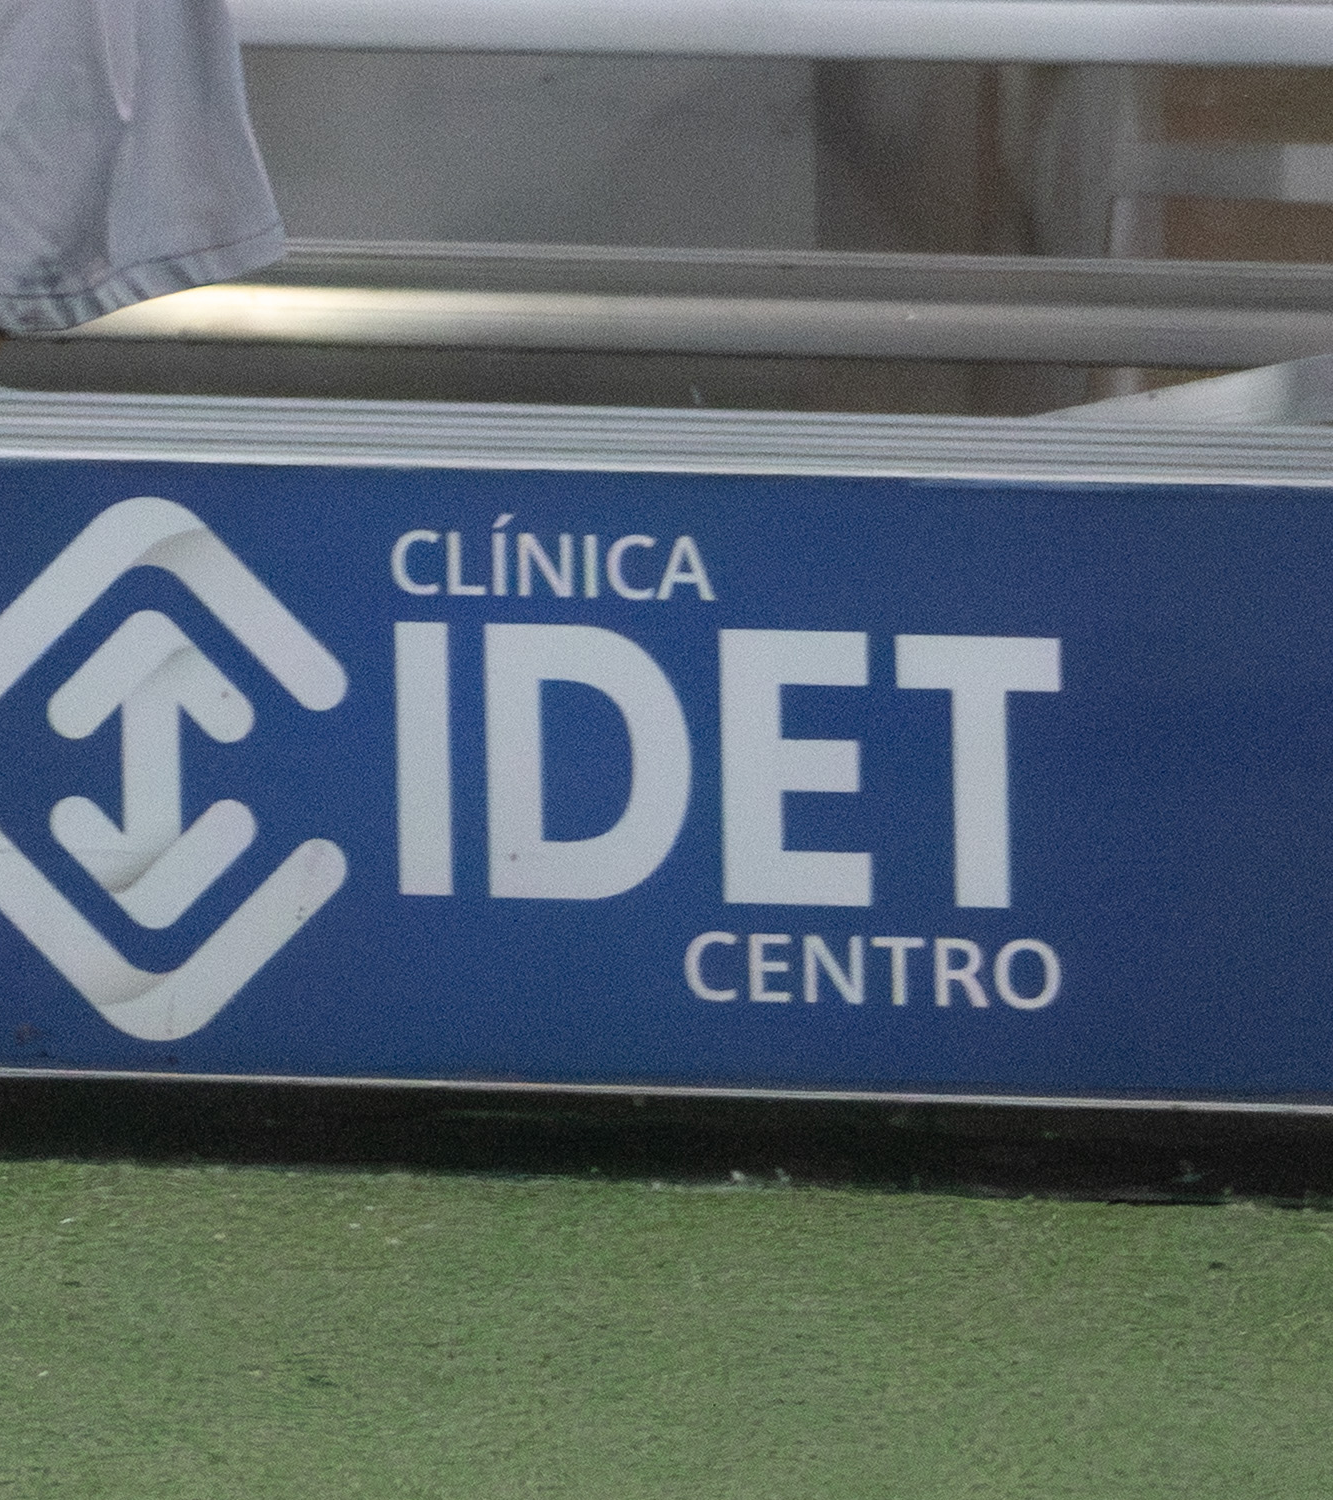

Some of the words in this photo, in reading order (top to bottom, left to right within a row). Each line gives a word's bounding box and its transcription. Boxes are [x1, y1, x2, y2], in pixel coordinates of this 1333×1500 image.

[392, 514, 715, 601] CLÍNICA
[394, 621, 1062, 907] IDET
[684, 932, 1062, 1010] CENTRO
